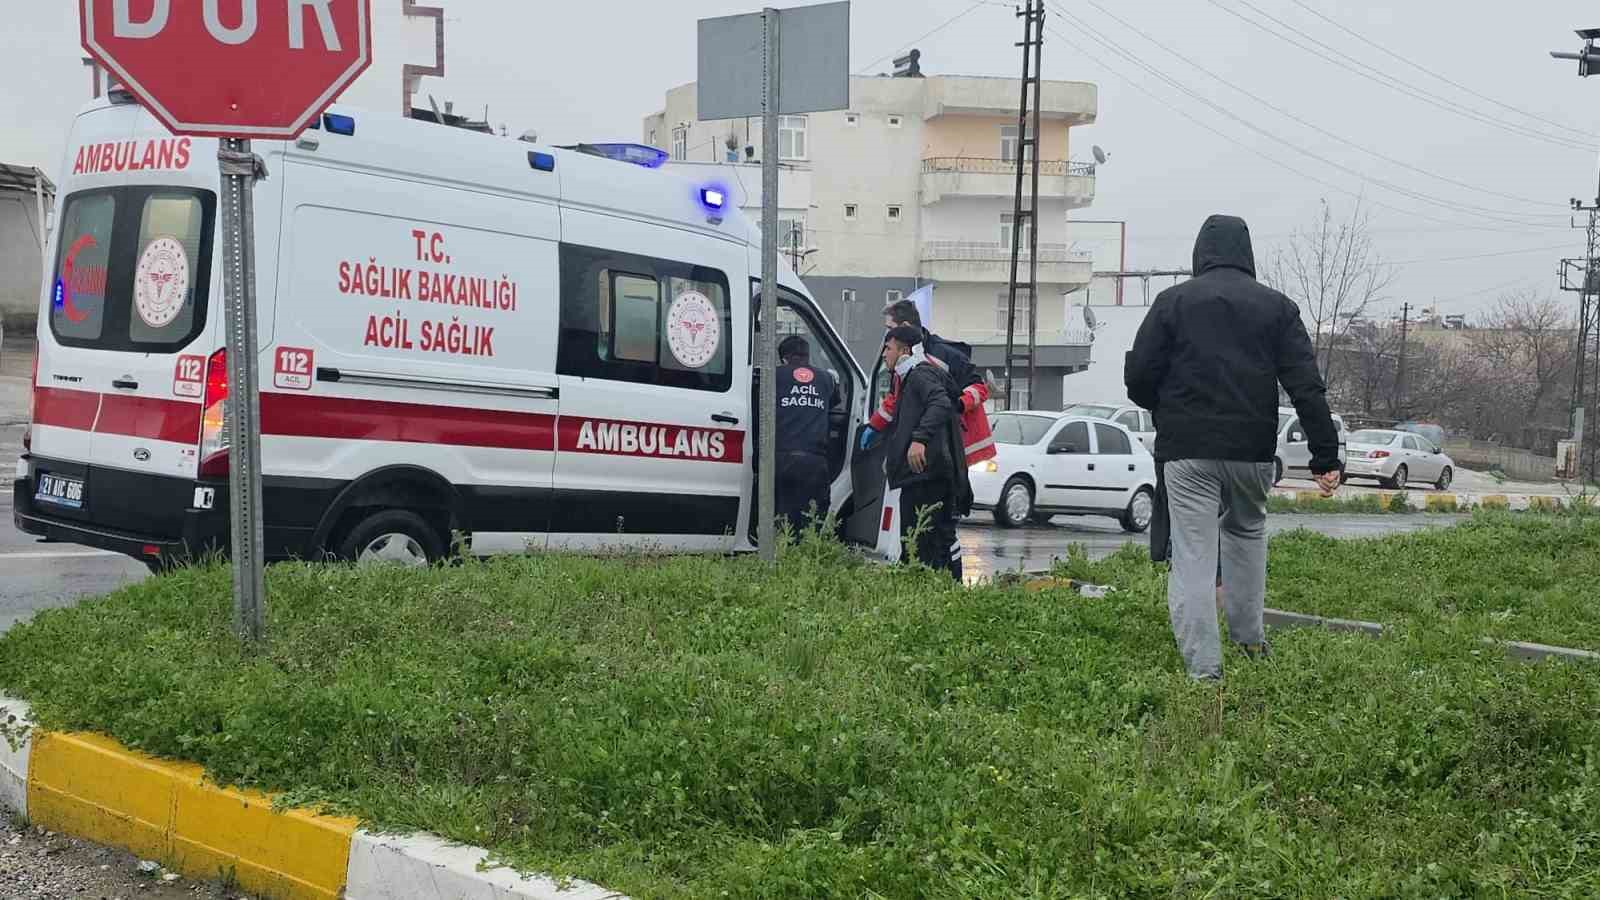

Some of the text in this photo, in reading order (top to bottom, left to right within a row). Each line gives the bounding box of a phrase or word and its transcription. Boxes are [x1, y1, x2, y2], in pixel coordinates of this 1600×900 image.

[73, 138, 192, 175] AMBULANS
[412, 229, 451, 264] T.C.
[338, 256, 516, 312] SAĞLIK BAKANLIĞI
[364, 309, 494, 357] ACİL SAĞLIK
[179, 359, 201, 380] 112
[280, 351, 308, 373] 112
[781, 395, 825, 410] SAĞLIK
[790, 384, 819, 396] ACİL
[576, 421, 725, 459] AMBULANS
